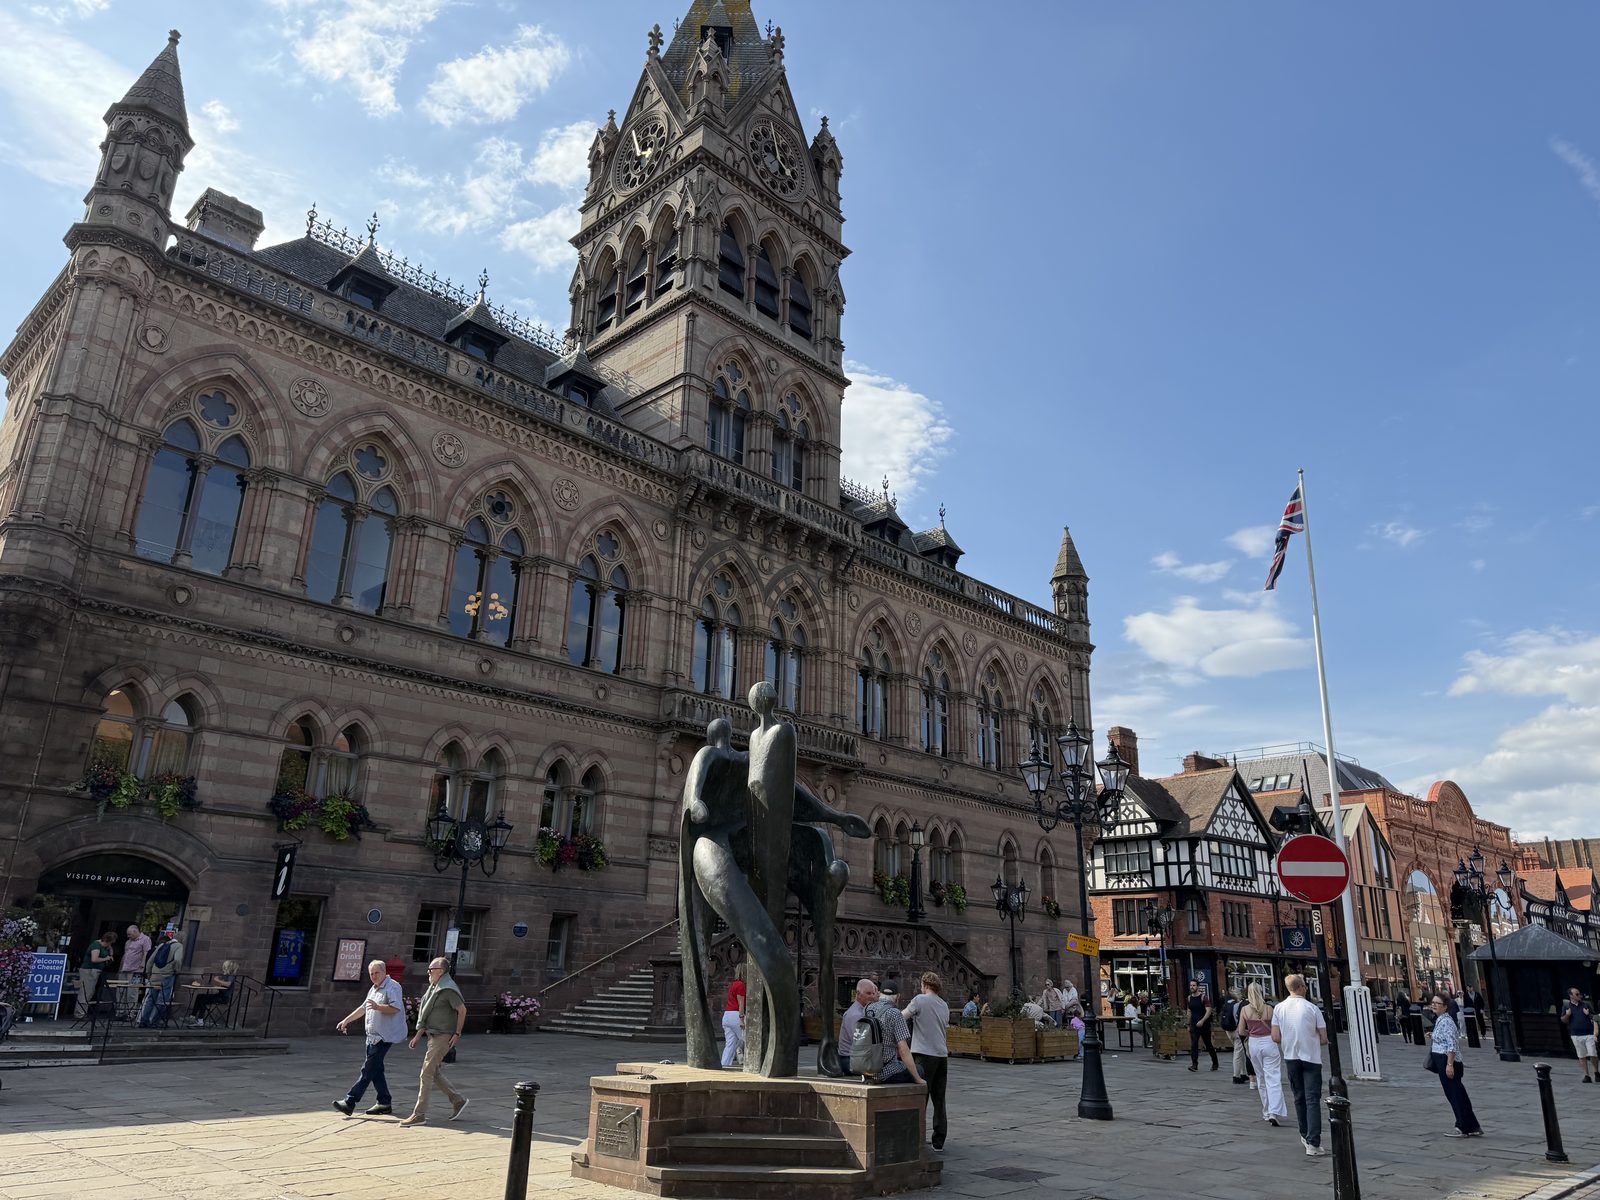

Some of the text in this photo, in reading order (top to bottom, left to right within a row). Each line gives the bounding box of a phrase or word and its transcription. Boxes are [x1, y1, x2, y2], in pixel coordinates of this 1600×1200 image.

[66, 872, 166, 886] VISITOR INFORMATION
[341, 942, 364, 952] HOT
[28, 973, 61, 984] TOUR
